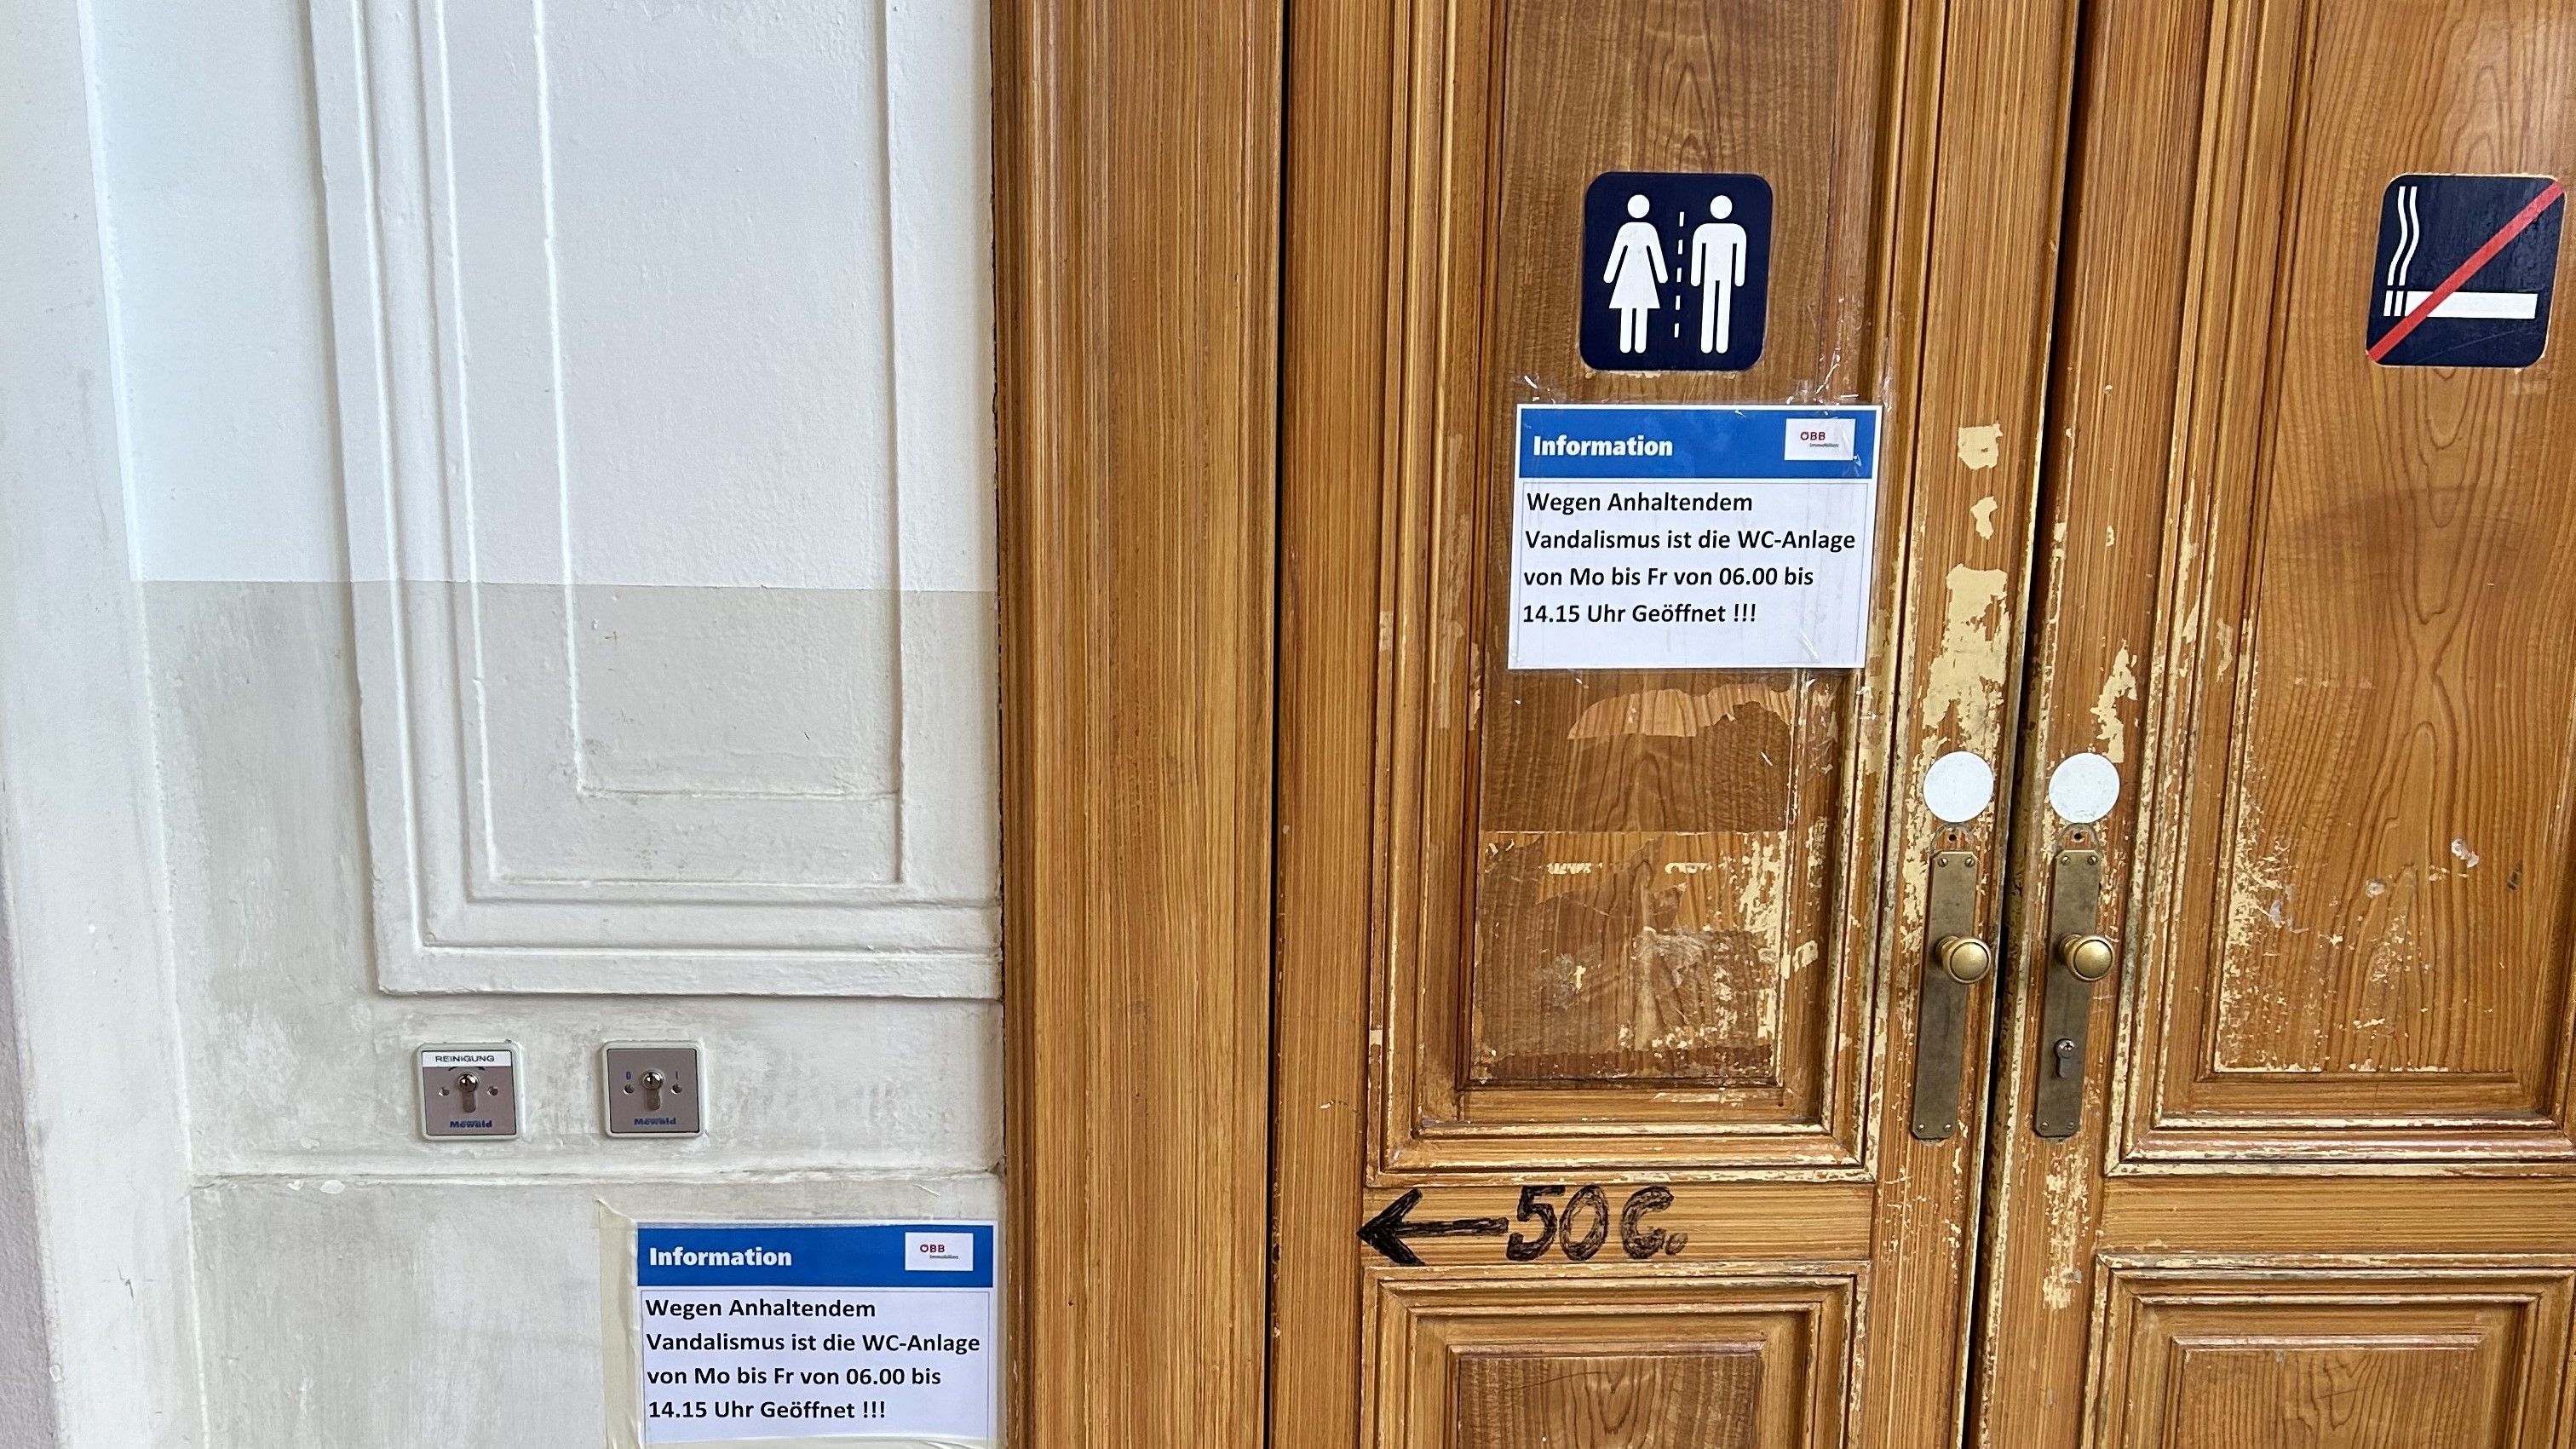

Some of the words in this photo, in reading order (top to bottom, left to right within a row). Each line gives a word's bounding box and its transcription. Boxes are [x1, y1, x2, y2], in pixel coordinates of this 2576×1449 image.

[1533, 434, 1673, 457] Information
[1527, 492, 1601, 515] Wegen
[1607, 492, 1752, 511] Anhaltendem
[1525, 529, 1660, 549] Vandalismus
[1667, 529, 1692, 549] ist
[1698, 529, 1731, 549] die
[1737, 529, 1855, 553] WC-Anlage
[1523, 572, 1562, 586] von
[1570, 567, 1605, 586] Mo
[1612, 566, 1641, 586] bis
[1647, 567, 1668, 585] Fr
[1673, 572, 1712, 585] von
[1719, 567, 1778, 586] 06.00
[1784, 566, 1814, 586] bis
[1523, 605, 1580, 623] 14.15
[1587, 603, 1626, 623] Uhr
[1632, 603, 1727, 623] Geöffnet
[1734, 603, 1757, 623] !!!
[435, 1055, 495, 1063] REINIGUNG
[1505, 1184, 1609, 1262] 50
[650, 1246, 792, 1266] Information
[645, 1299, 722, 1320] Wegen
[728, 1297, 876, 1317] Anhaltendem
[646, 1332, 785, 1351] Vandalismus
[791, 1333, 817, 1351] ist
[823, 1333, 856, 1352] die
[861, 1333, 980, 1355] WC-Anlage
[647, 1371, 687, 1384] von
[694, 1367, 730, 1384] Mo
[737, 1366, 768, 1384] bis
[774, 1367, 795, 1384] Fr
[800, 1371, 839, 1385] von
[846, 1368, 906, 1385] 06.00
[911, 1367, 941, 1385] bis
[648, 1401, 707, 1418] 14.15
[715, 1400, 755, 1418] Uhr
[760, 1400, 855, 1419] Geöffnet
[863, 1400, 885, 1418] !!!
